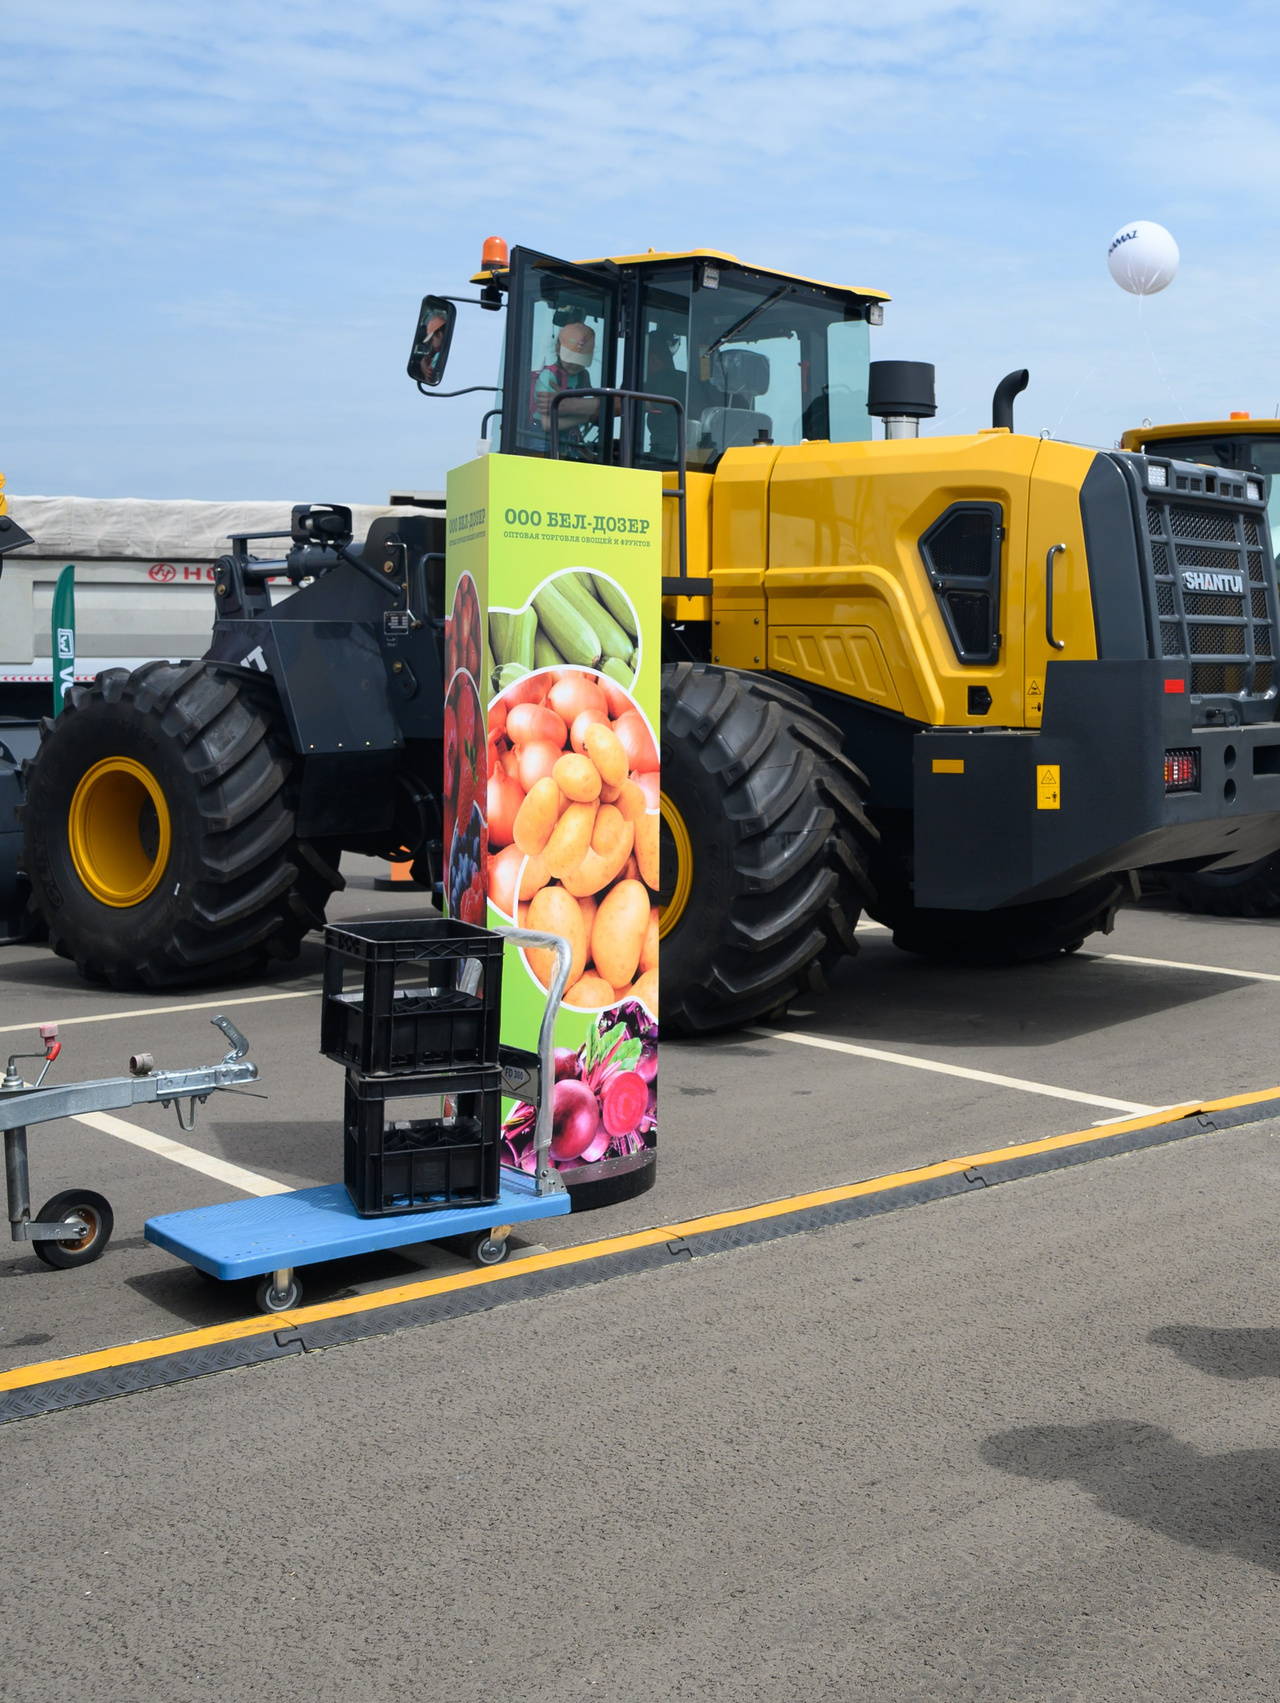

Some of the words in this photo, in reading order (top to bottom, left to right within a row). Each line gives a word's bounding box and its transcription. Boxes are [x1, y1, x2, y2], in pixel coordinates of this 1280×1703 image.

[504, 508, 542, 526] ООО
[546, 511, 650, 534] БЕЛ-ДОЗЕР
[503, 531, 540, 540] ОПТОВАЯ
[541, 533, 580, 543] ТОРГОВЛЯ
[581, 536, 612, 545] ОВОЩЕЙ
[620, 539, 651, 547] ФРУКТОВ
[1185, 571, 1243, 593] SHANTUI
[505, 1067, 513, 1077] FD
[514, 1070, 523, 1080] 300
